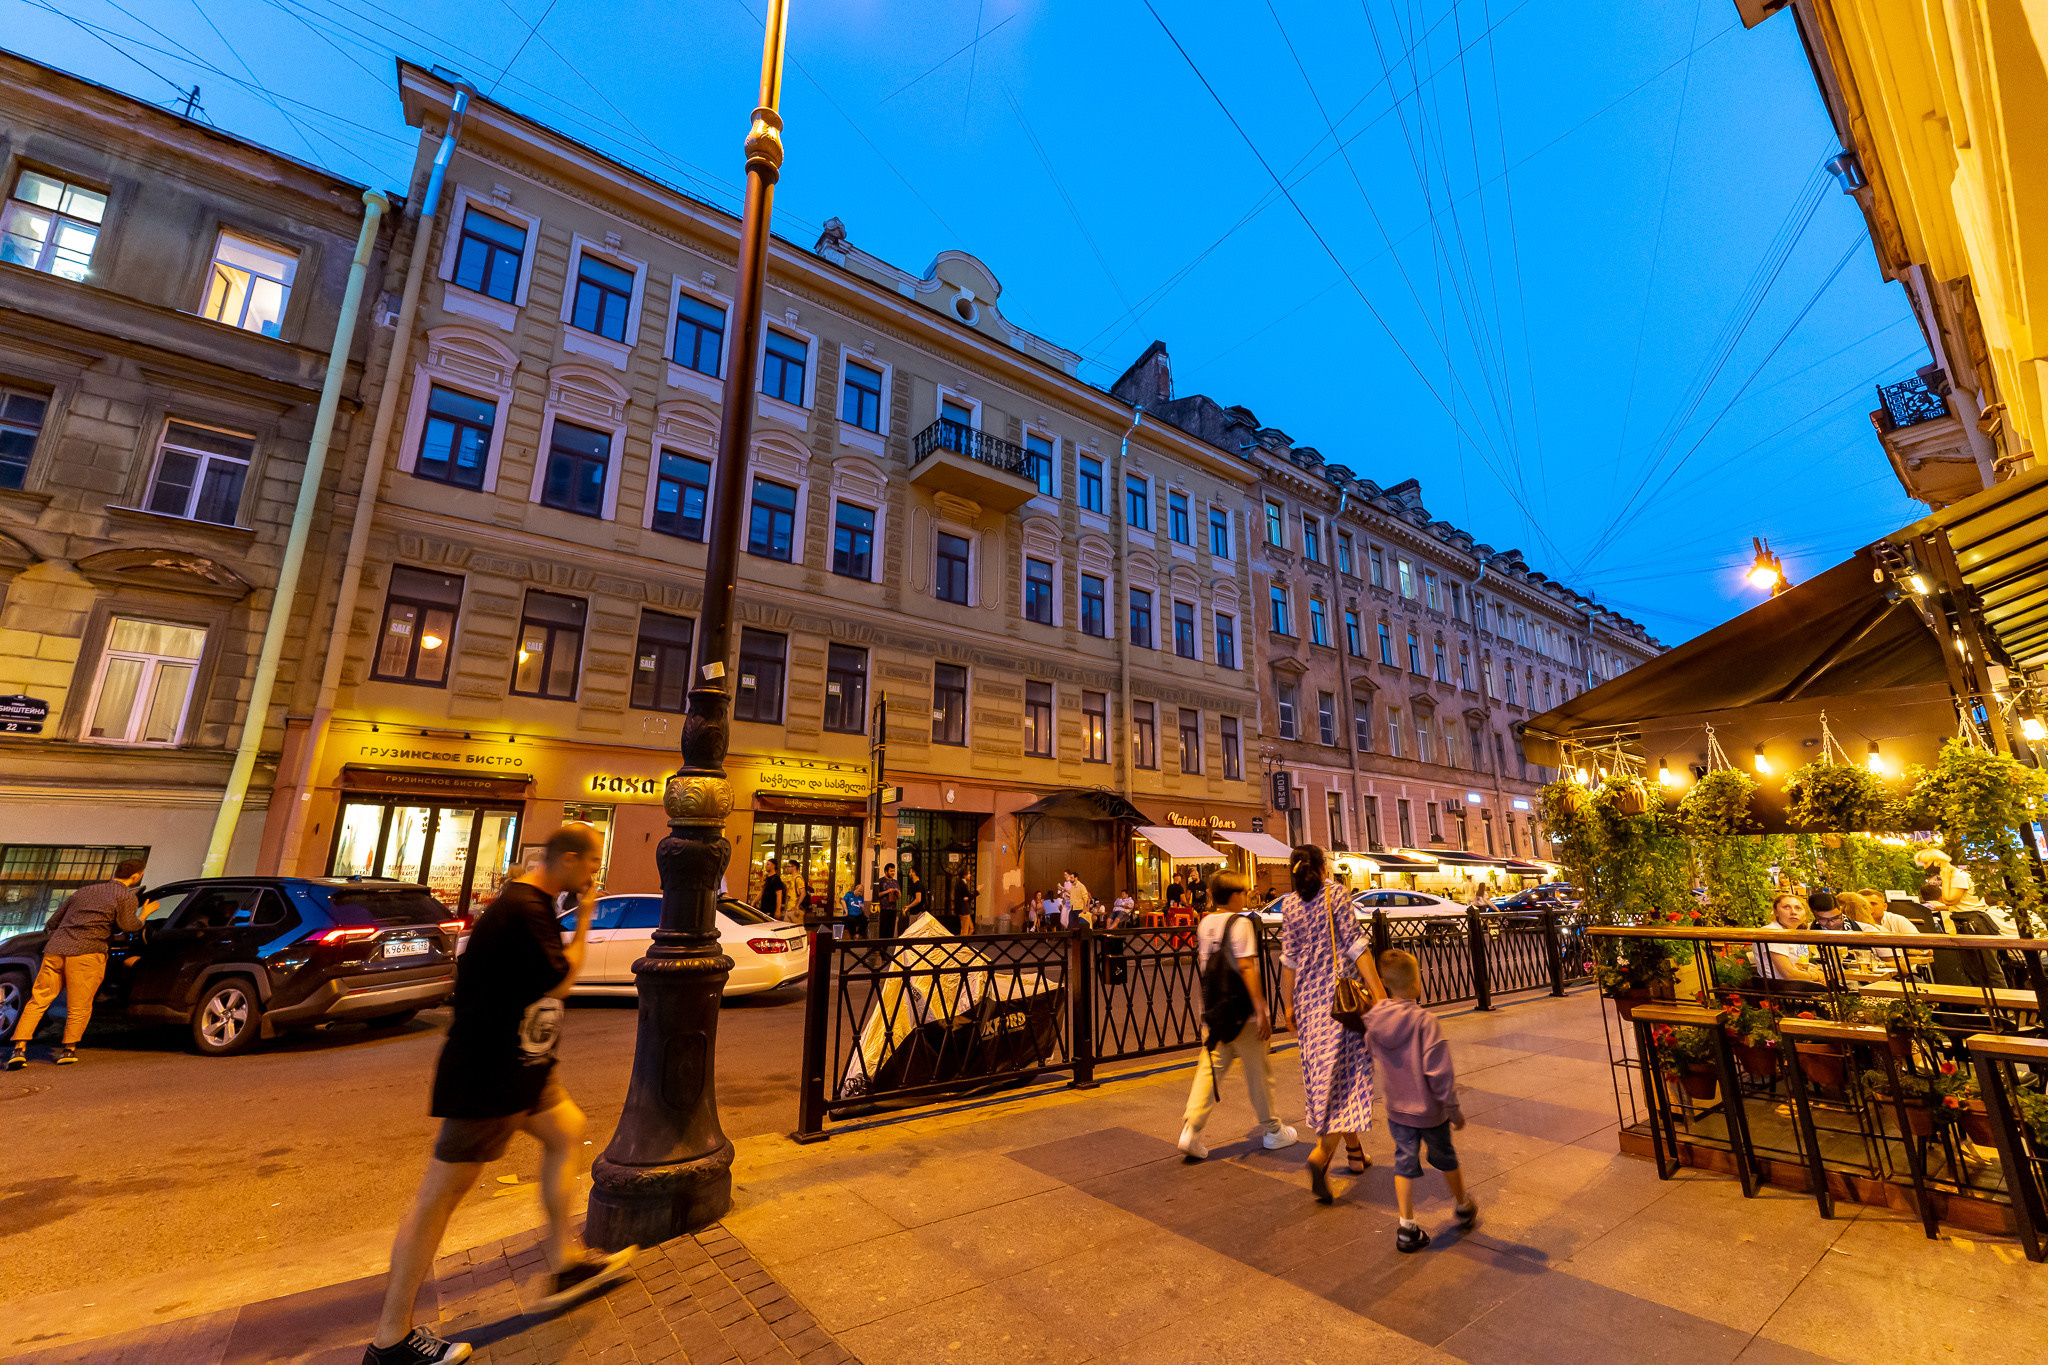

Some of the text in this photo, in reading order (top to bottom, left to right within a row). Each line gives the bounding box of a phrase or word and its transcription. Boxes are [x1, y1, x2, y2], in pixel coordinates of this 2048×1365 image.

[391, 622, 411, 635] SALE
[526, 641, 543, 652] SALE
[640, 659, 655, 669] SALE
[742, 676, 755, 686] SALE
[828, 684, 840, 693] SALE
[6, 723, 18, 731] 22
[360, 746, 523, 767] ГРУЗИНСКОЕ БИСТРО
[386, 775, 491, 789] ГРУЗИНСКОЕ БИСТРО
[808, 778, 823, 790] და
[824, 777, 867, 794] სასმელი
[1167, 811, 1207, 828] Чайный
[1209, 815, 1237, 829] Домъ
